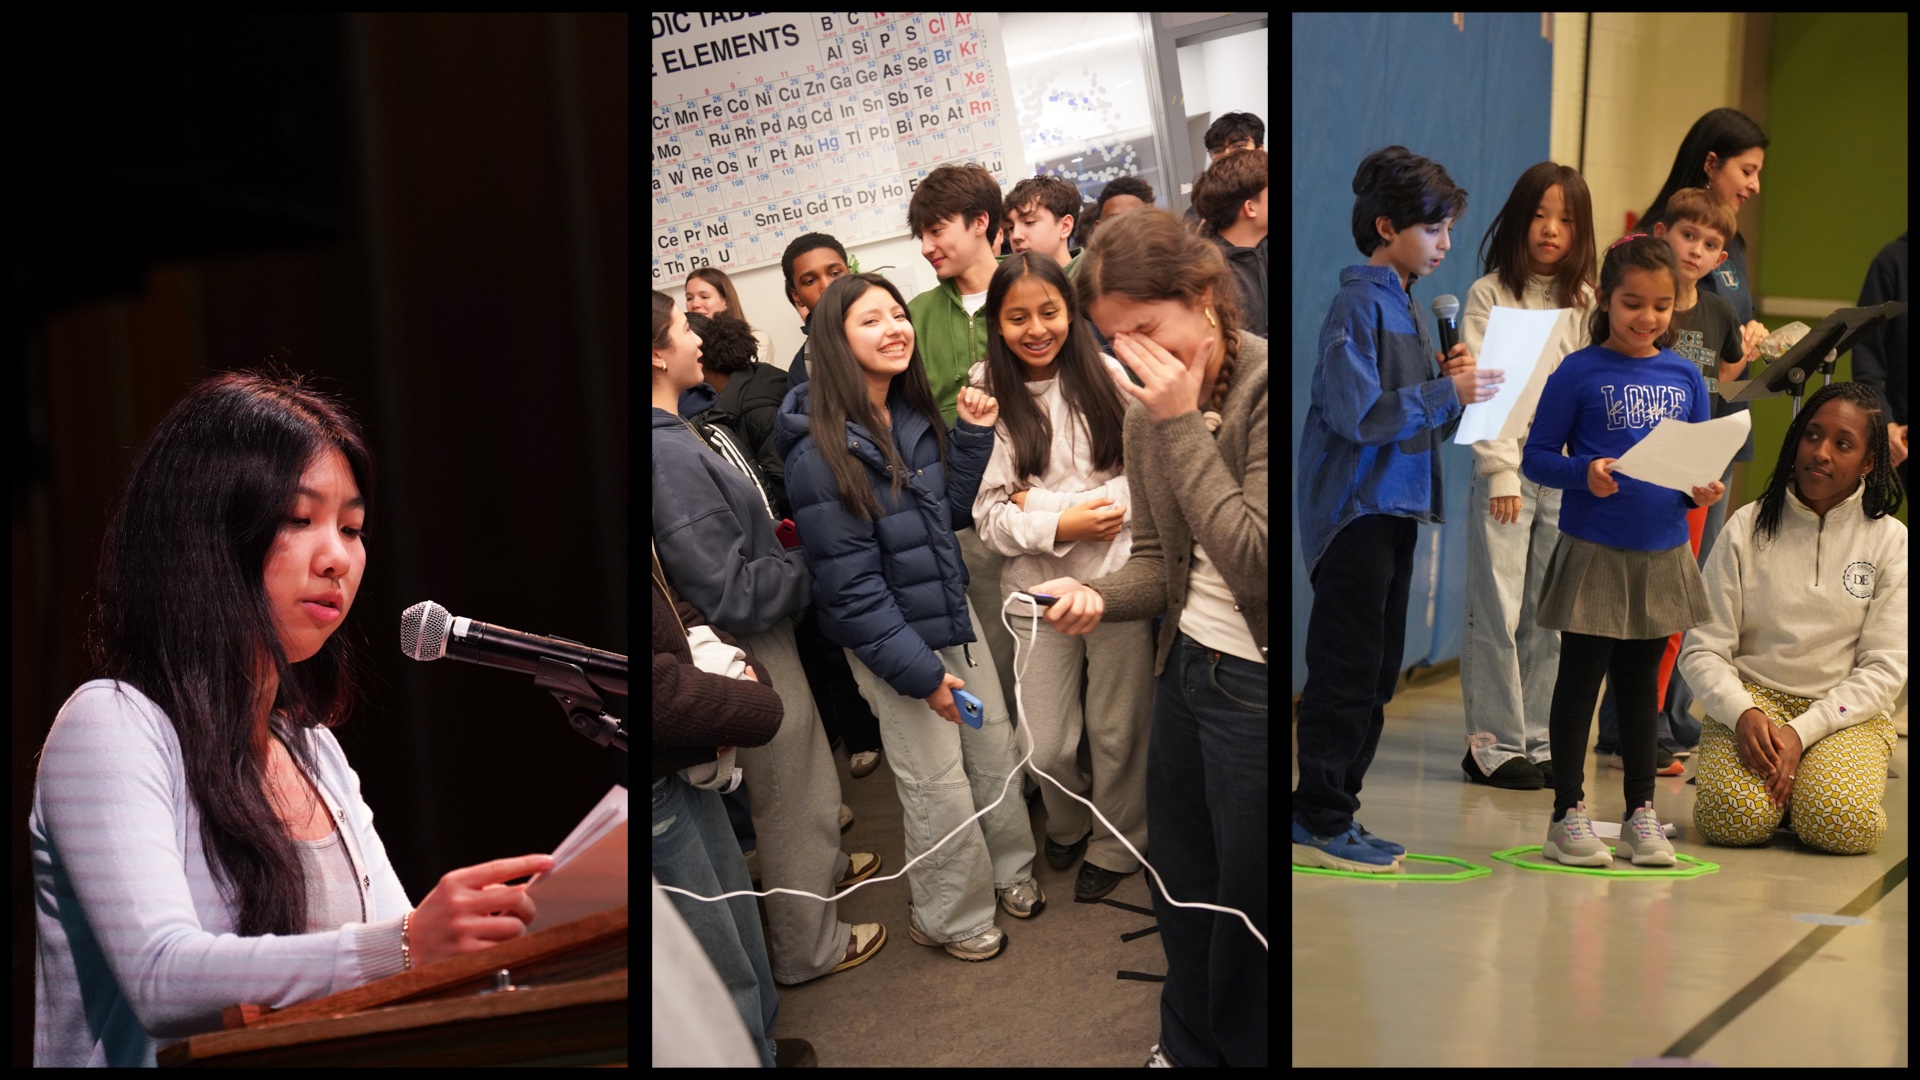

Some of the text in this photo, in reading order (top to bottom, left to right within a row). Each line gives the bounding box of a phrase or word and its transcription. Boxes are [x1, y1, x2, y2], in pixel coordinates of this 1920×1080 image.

[821, 16, 833, 31] B
[848, 12, 859, 25] C
[828, 12, 972, 61] Al Si P S Cl Ar
[835, 36, 844, 44] 13
[886, 23, 895, 32] 15
[912, 16, 921, 24] 16
[661, 23, 800, 74] ELEMENTS
[661, 107, 670, 115] 24
[687, 101, 697, 109] 25
[738, 89, 746, 97] 27
[764, 83, 773, 92] 28
[790, 78, 799, 86] 29
[842, 66, 849, 74] 31
[868, 60, 877, 68] 32
[893, 53, 901, 61] 33
[944, 39, 953, 48] 35
[970, 32, 979, 41] 36
[652, 42, 976, 130] Cr Mn Fe Co Ni Cu Zn Ga Ge As Se Br Kr
[678, 93, 683, 101] 7
[754, 76, 764, 84] 10
[780, 70, 789, 78] 11
[806, 64, 815, 72] 12
[695, 129, 704, 137] 43
[898, 82, 906, 90] 51
[923, 75, 933, 84] 52
[949, 68, 959, 76] 53
[975, 61, 985, 70] 54
[657, 144, 681, 159] Mo
[709, 133, 731, 147] Ru
[734, 126, 756, 141] Rh
[761, 119, 781, 136] Pd
[788, 115, 807, 130] Ag
[811, 108, 833, 124] Cd
[840, 105, 855, 118] In
[863, 98, 883, 112] Sn
[888, 91, 908, 106] Sb
[913, 85, 932, 99] Te
[964, 71, 985, 86] Xe
[752, 145, 761, 153] 77
[904, 110, 914, 118] 83
[980, 90, 989, 99] 86
[656, 196, 668, 204] 105
[706, 184, 718, 192] 107
[756, 173, 769, 181] 109
[782, 167, 794, 175] 110
[908, 138, 920, 146] 115
[956, 125, 970, 134] 117
[984, 119, 996, 127] 118
[668, 170, 683, 185] W
[692, 167, 713, 180] Re
[717, 161, 738, 174] Os
[747, 155, 757, 168] Ir
[770, 149, 787, 163] Pt
[795, 144, 813, 158] Au
[817, 137, 840, 152] Hg
[846, 130, 861, 145] Tl
[869, 126, 889, 140] Pb
[896, 117, 912, 134] Bi
[920, 114, 939, 128] Po
[948, 106, 964, 121] At
[969, 101, 991, 115] Rn
[658, 236, 678, 248] Ce
[684, 230, 700, 243] Pr
[707, 222, 728, 237] Nd
[755, 214, 780, 226] Sm
[782, 207, 802, 221] Eu
[807, 199, 828, 215] Gd
[832, 195, 852, 209] Tb
[857, 190, 876, 204] Dy
[882, 185, 903, 198] Ho
[717, 215, 726, 223] 60
[743, 209, 750, 217] 61
[792, 198, 803, 206] 63
[774, 230, 783, 238] 94
[664, 261, 684, 274] Th
[690, 256, 708, 269] Pa
[719, 249, 729, 262] U
[1600, 385, 1686, 430] LOVE
[1853, 573, 1870, 586] DE
